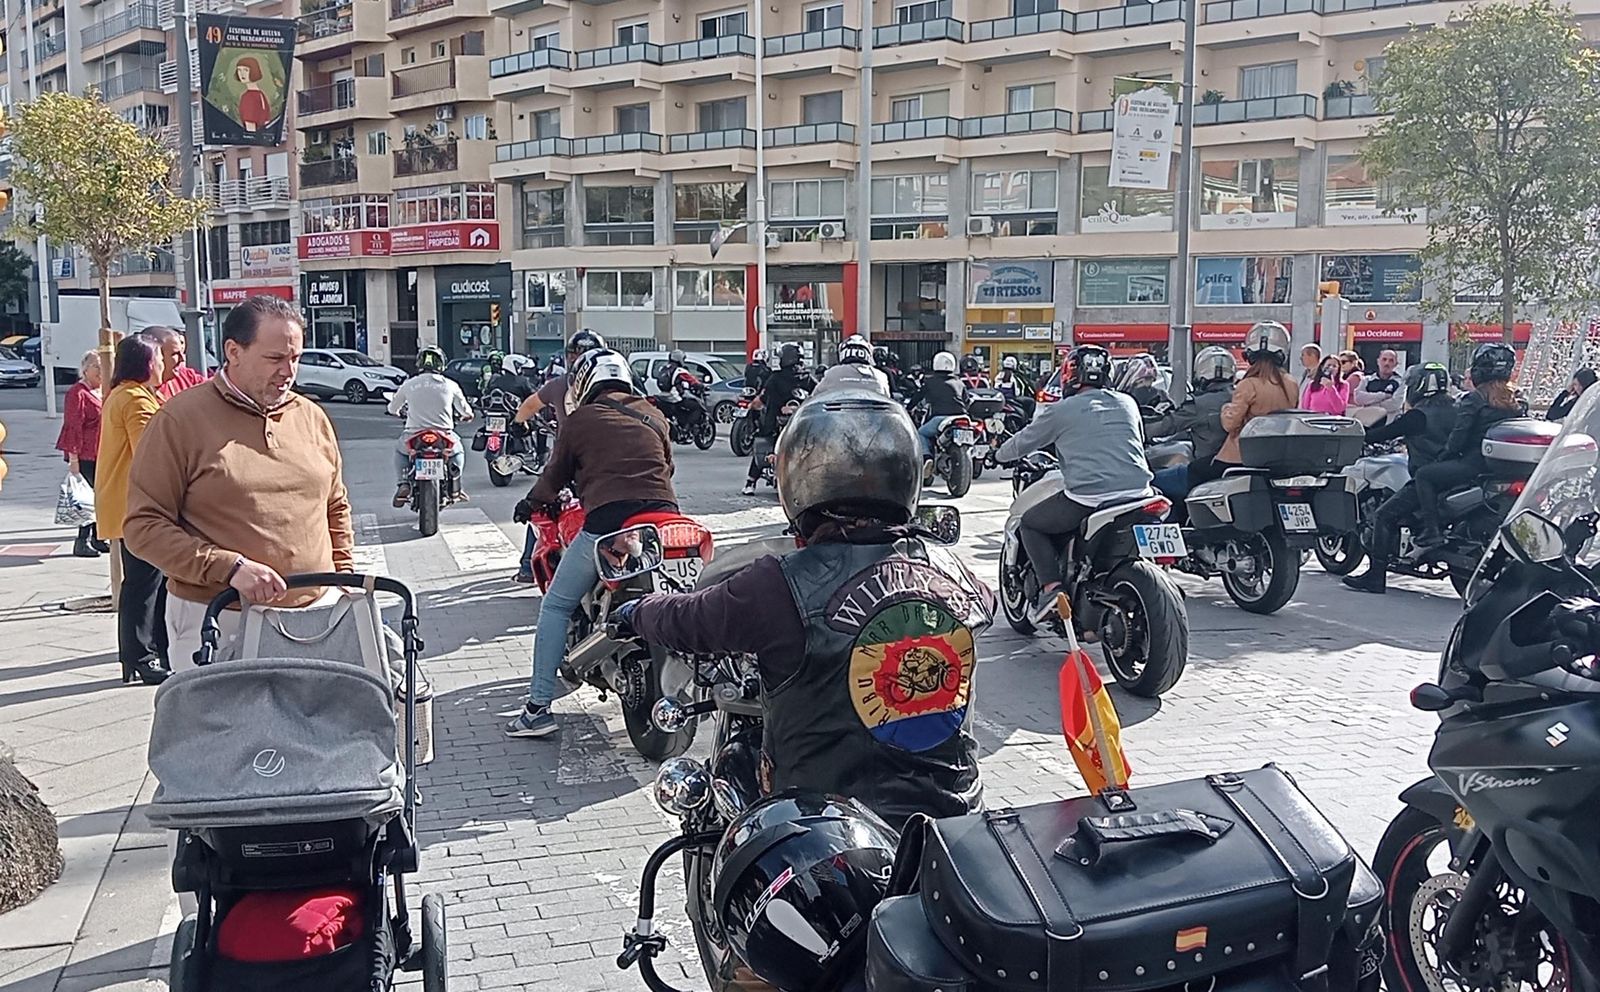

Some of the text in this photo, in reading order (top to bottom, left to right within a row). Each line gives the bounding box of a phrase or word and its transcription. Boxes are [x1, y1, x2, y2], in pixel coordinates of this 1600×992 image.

[206, 26, 221, 44] 49
[307, 235, 343, 247] ABOGADOS
[428, 237, 460, 246] PROPIEDAD
[271, 246, 291, 255] VENDE
[1205, 273, 1233, 284] alfa
[451, 280, 490, 293] audicost
[983, 285, 1042, 297] TARTESSOS
[222, 290, 247, 299] MAPFRE
[309, 294, 320, 304] DEL
[1294, 517, 1311, 527] JVP
[1146, 527, 1180, 541] 2743
[1150, 541, 1176, 554] GWD
